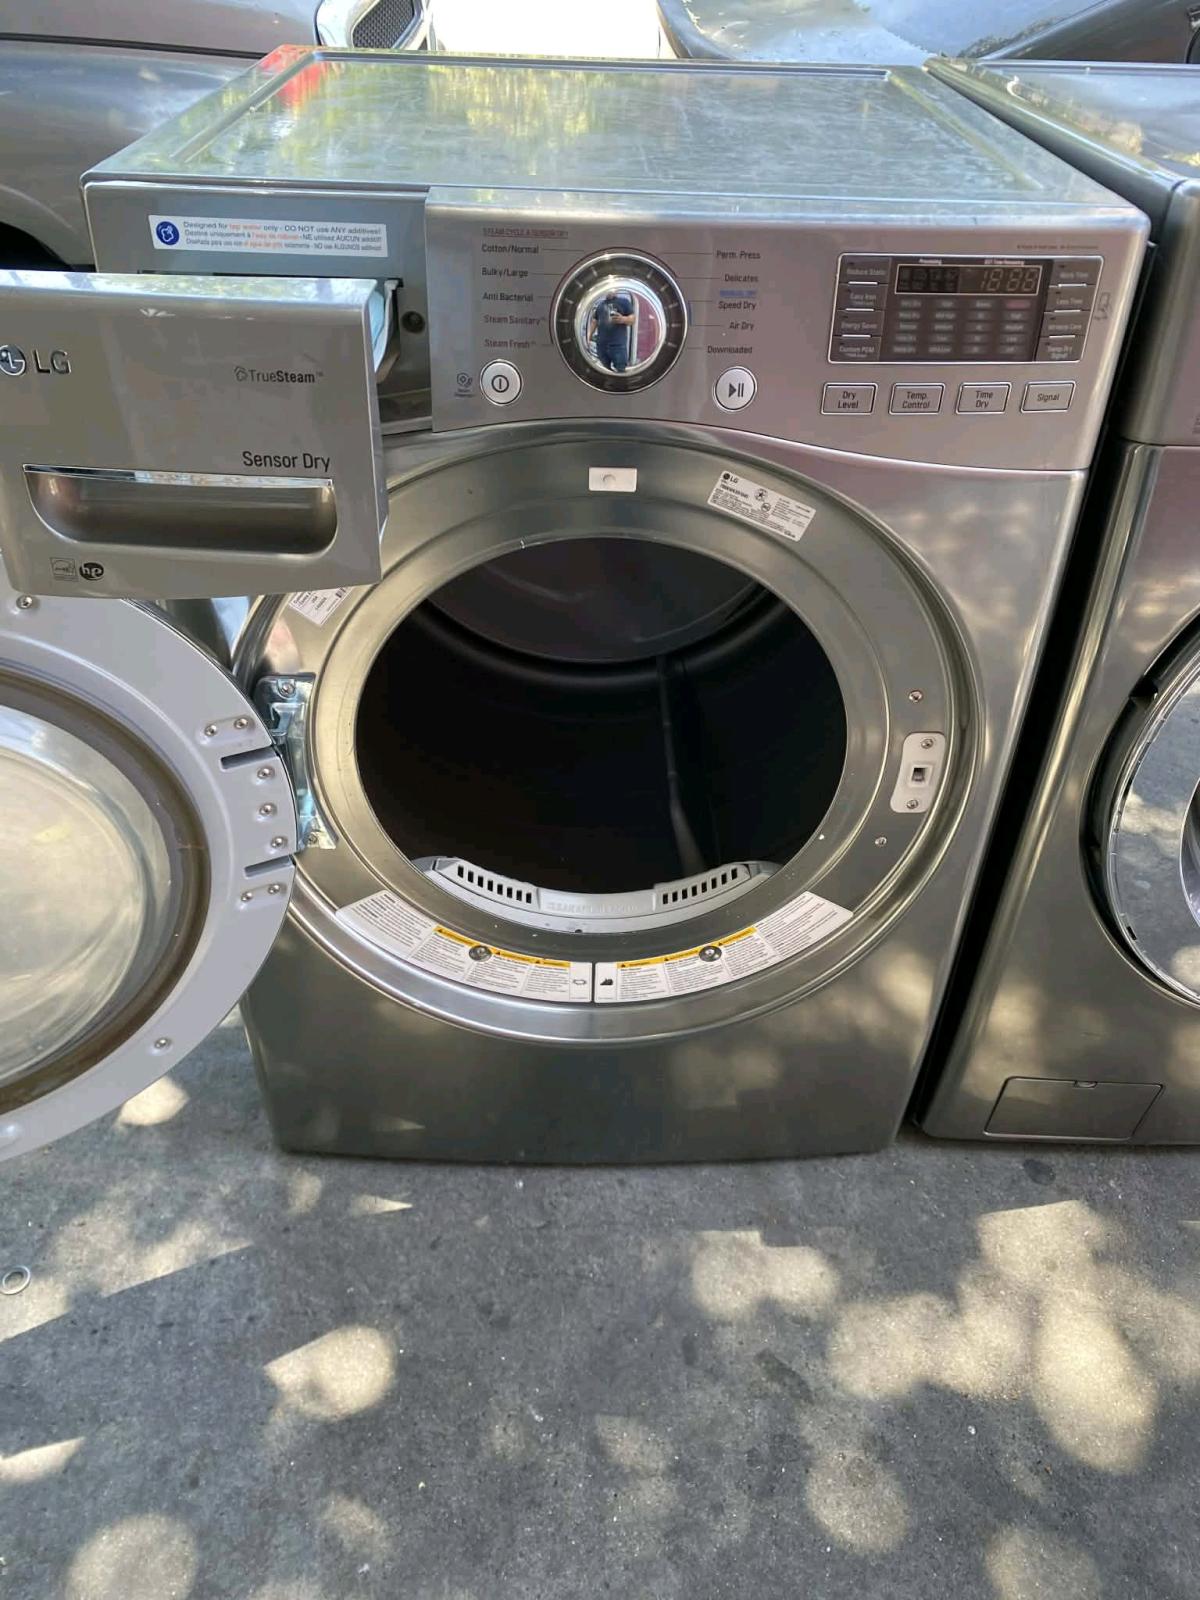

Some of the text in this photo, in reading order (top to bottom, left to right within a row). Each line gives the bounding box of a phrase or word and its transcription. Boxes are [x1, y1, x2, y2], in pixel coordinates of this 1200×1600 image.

[184, 221, 217, 230] Designed
[264, 224, 279, 232] only
[285, 224, 297, 232] DO
[299, 225, 315, 233] NOT
[330, 226, 346, 234] ANY
[482, 243, 540, 254] Cotton/Normal
[740, 251, 761, 260] Press
[482, 267, 529, 279] Bulky/Large
[724, 273, 759, 283] Delicates
[482, 292, 534, 302] Anti Bacterial
[718, 301, 757, 311] Speed Dry
[484, 314, 508, 324] Steam
[729, 321, 755, 331] Air Dry
[484, 338, 508, 348] Steam
[707, 345, 753, 354] Downloaded
[33, 348, 72, 375] LG
[842, 391, 856, 400] Dry
[976, 390, 994, 399] Time
[1037, 393, 1060, 403] Signal
[838, 401, 859, 409] Level
[902, 400, 930, 409] Control
[975, 400, 989, 409] Dry
[242, 450, 331, 473] Sensor Dry
